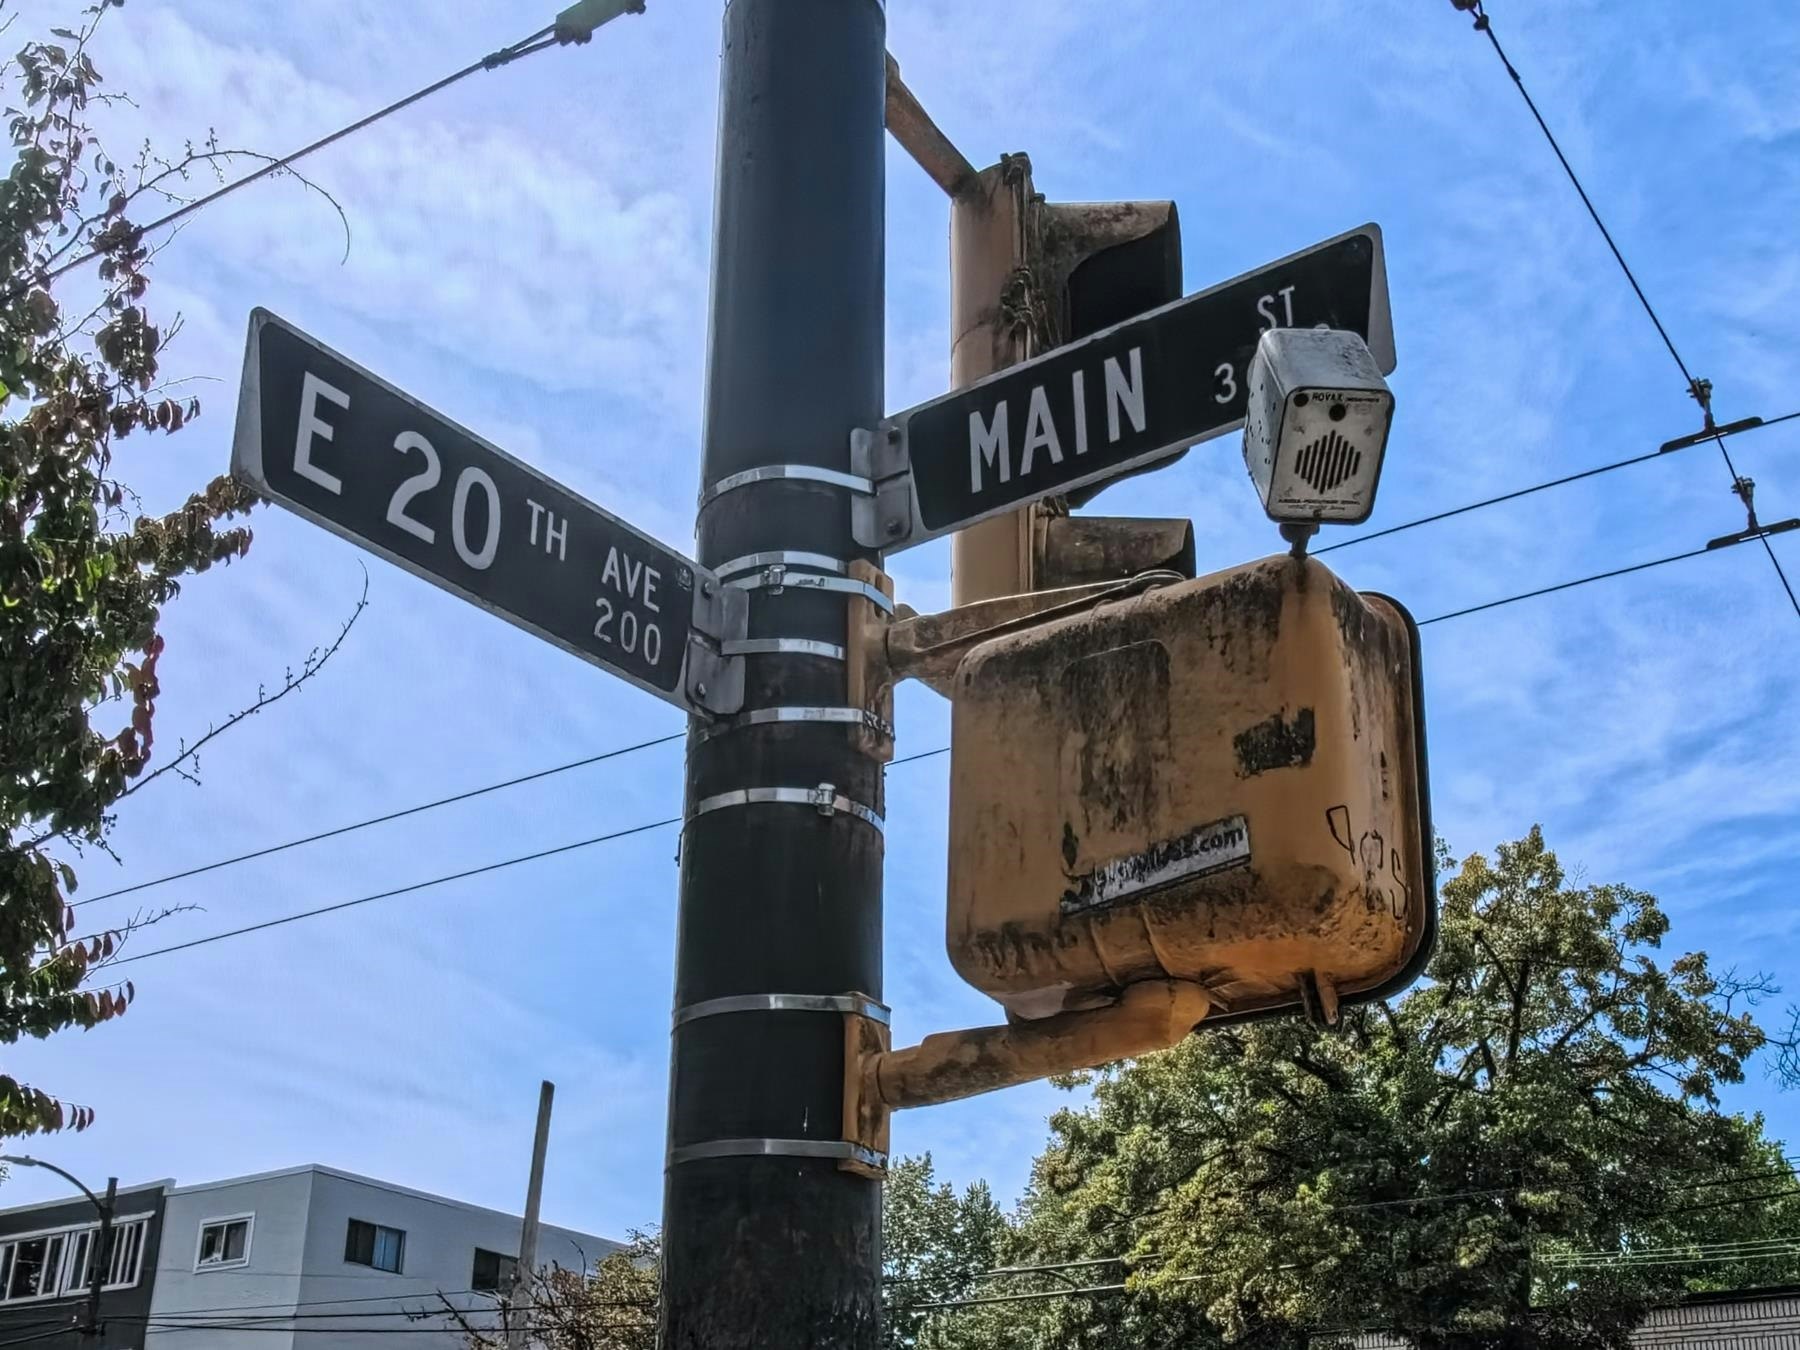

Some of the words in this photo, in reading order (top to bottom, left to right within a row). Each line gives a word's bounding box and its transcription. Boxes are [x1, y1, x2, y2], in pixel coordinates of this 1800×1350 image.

[293, 371, 351, 496] E
[386, 431, 501, 571] 20
[526, 498, 569, 561] TH
[601, 546, 662, 614] AVE
[969, 346, 1147, 494] MAIN
[1257, 285, 1296, 333] ST
[594, 597, 662, 667] 200
